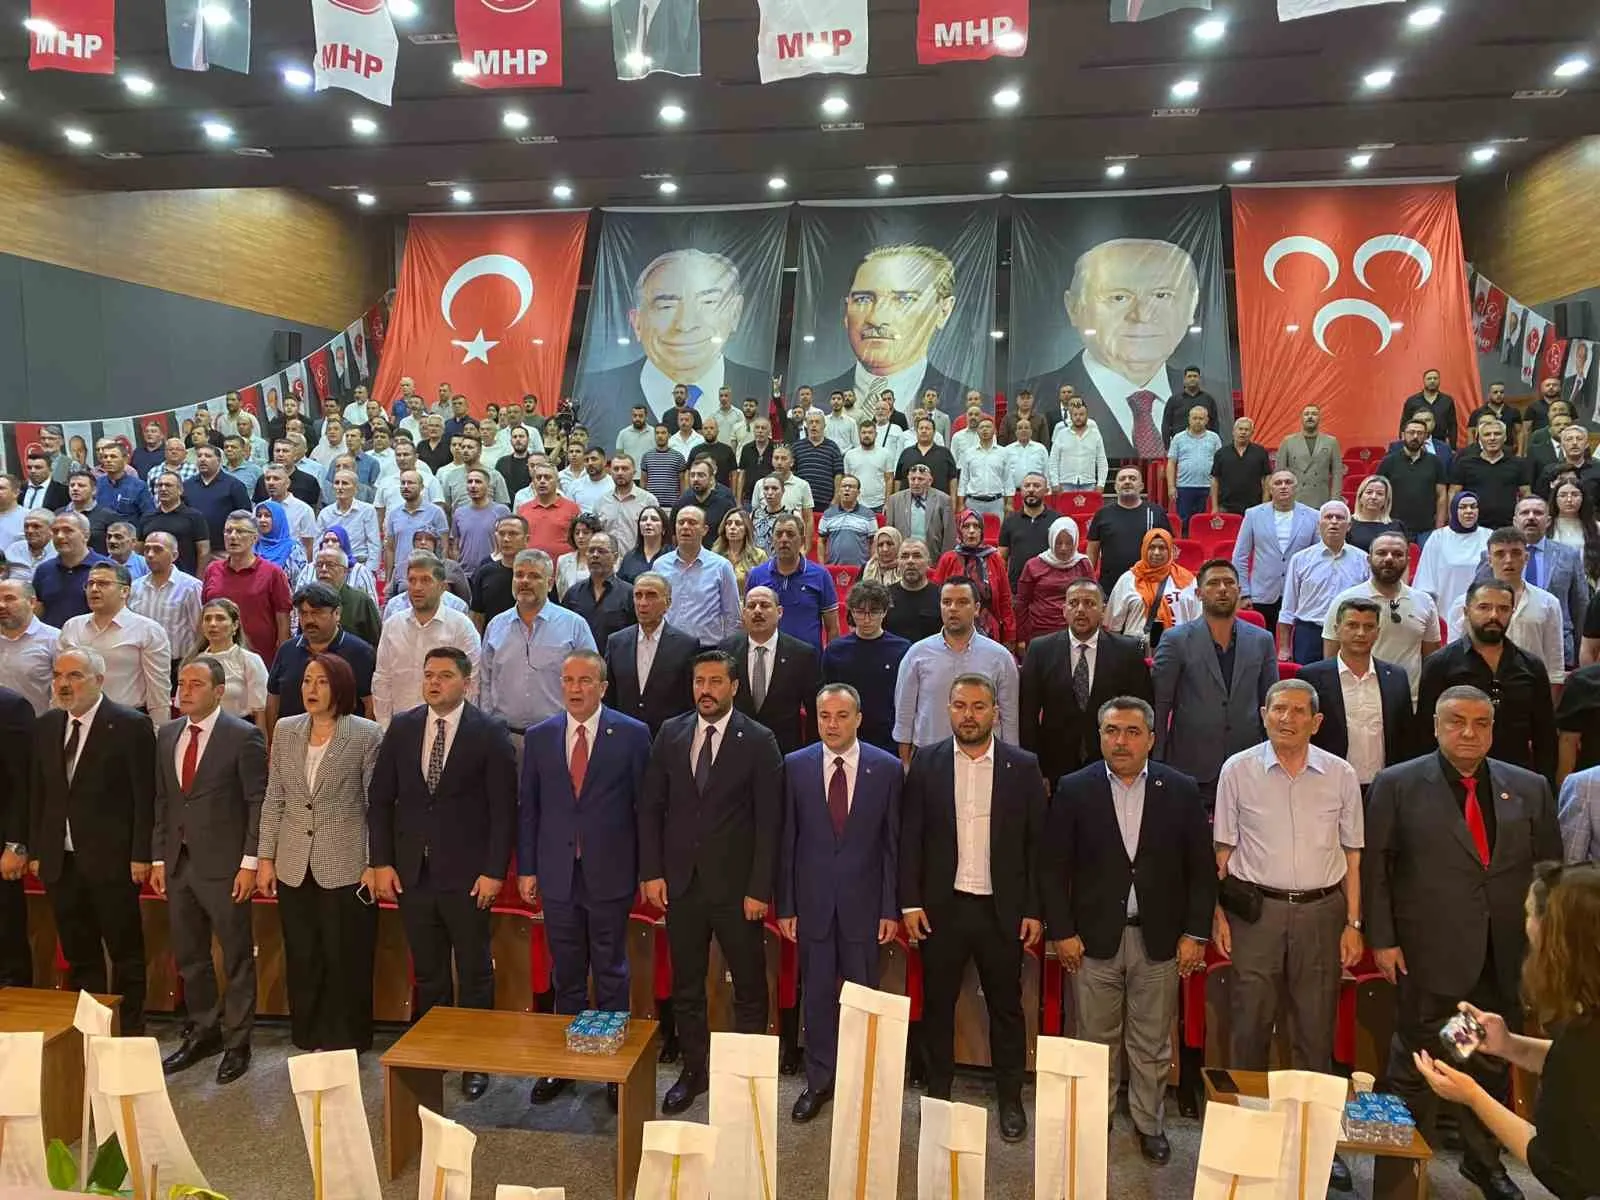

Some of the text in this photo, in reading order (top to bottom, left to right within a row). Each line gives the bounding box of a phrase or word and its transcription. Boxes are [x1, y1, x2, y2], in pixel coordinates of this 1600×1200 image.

[935, 17, 1013, 48] MHP
[322, 43, 383, 79] MHP
[473, 49, 547, 75] MHP
